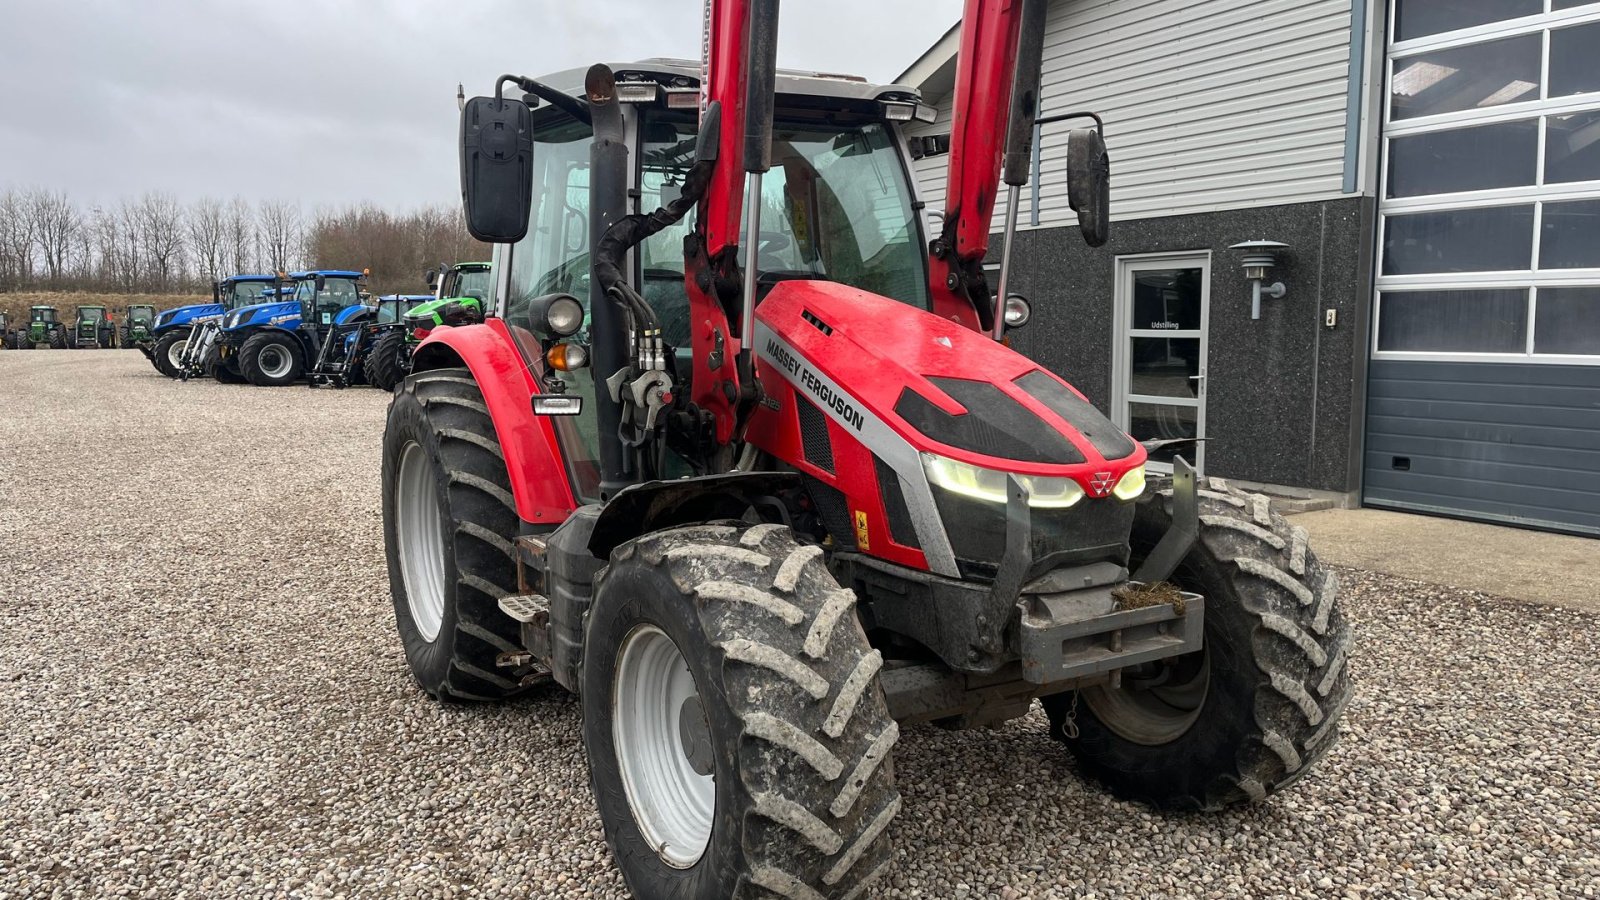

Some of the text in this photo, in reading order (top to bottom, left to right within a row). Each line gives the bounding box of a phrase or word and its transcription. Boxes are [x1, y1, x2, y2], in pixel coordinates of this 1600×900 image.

[1151, 321, 1179, 329] Udstilling
[766, 338, 864, 431] MASSEY FERGUSON
